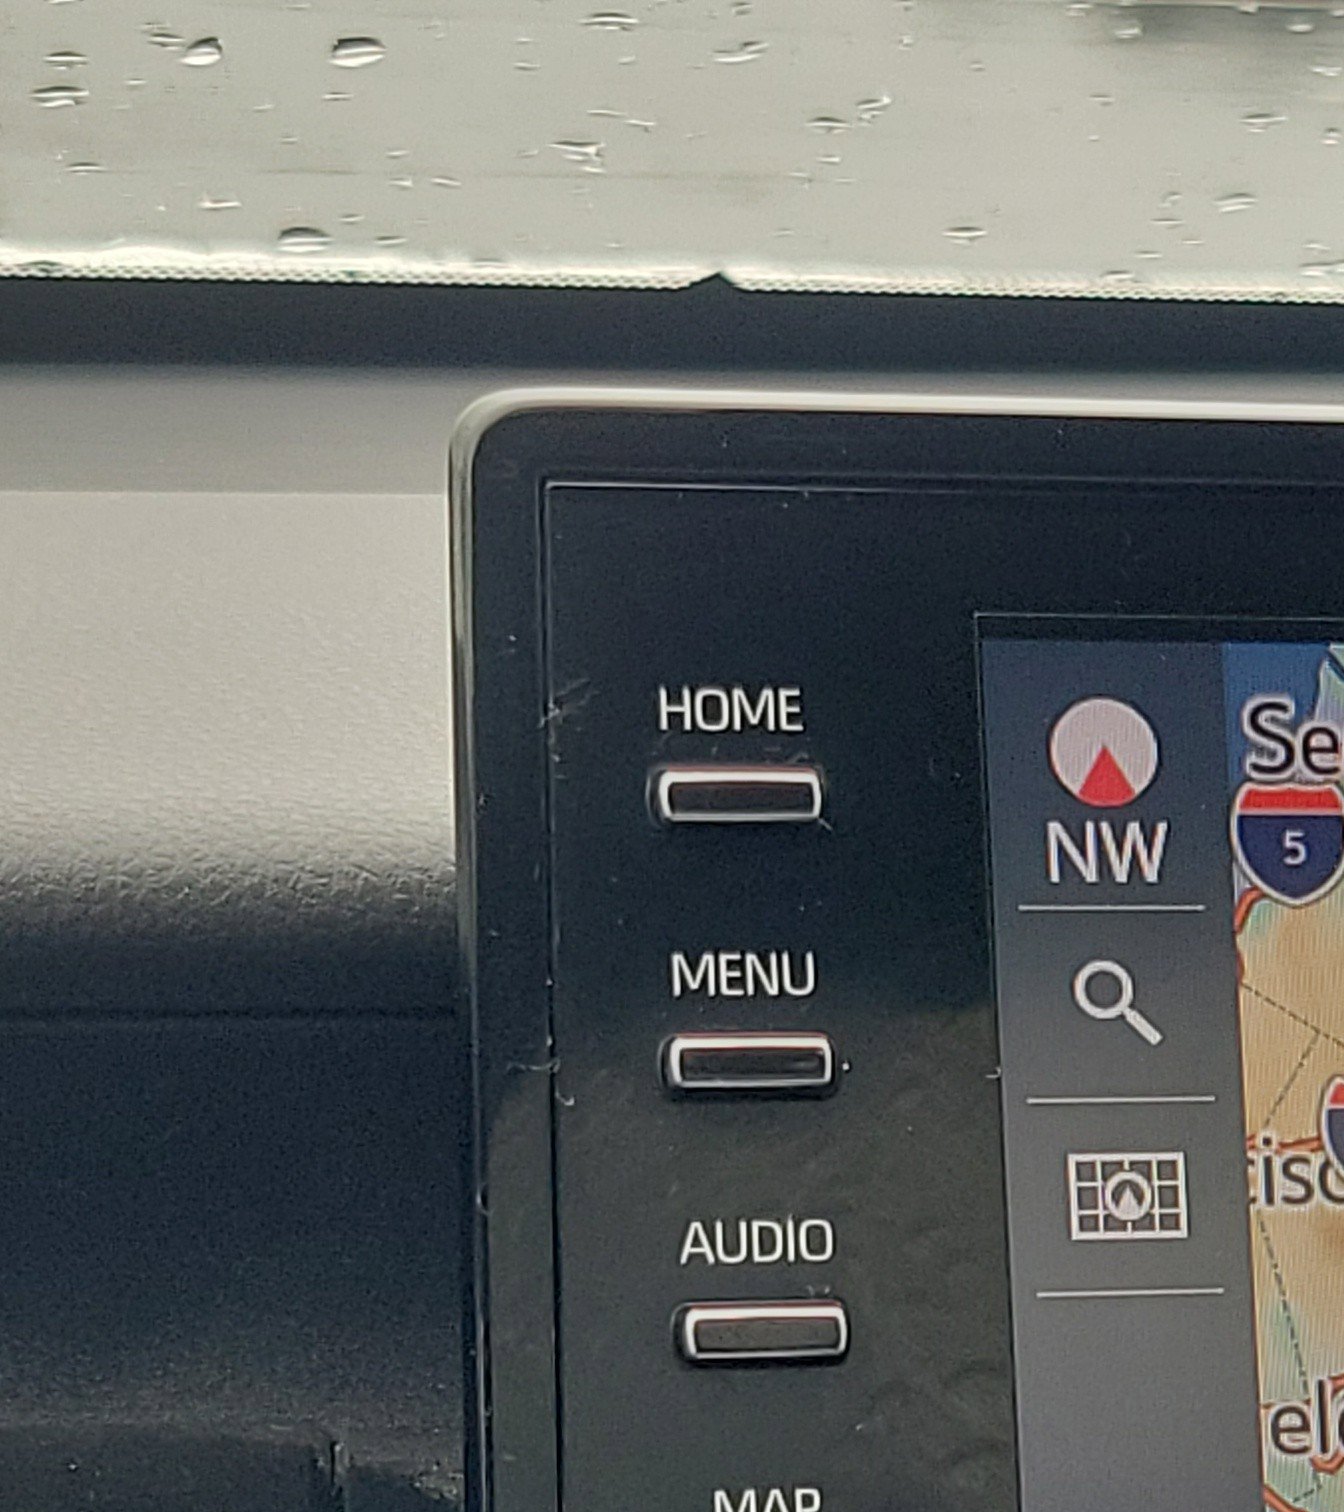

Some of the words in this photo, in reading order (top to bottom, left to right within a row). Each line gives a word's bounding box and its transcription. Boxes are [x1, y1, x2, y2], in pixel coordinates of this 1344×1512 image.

[658, 685, 805, 732] HOME
[1046, 820, 1169, 884] NW
[1282, 830, 1308, 866] 5
[671, 951, 817, 998] MENU
[680, 1214, 835, 1265] AUDIO
